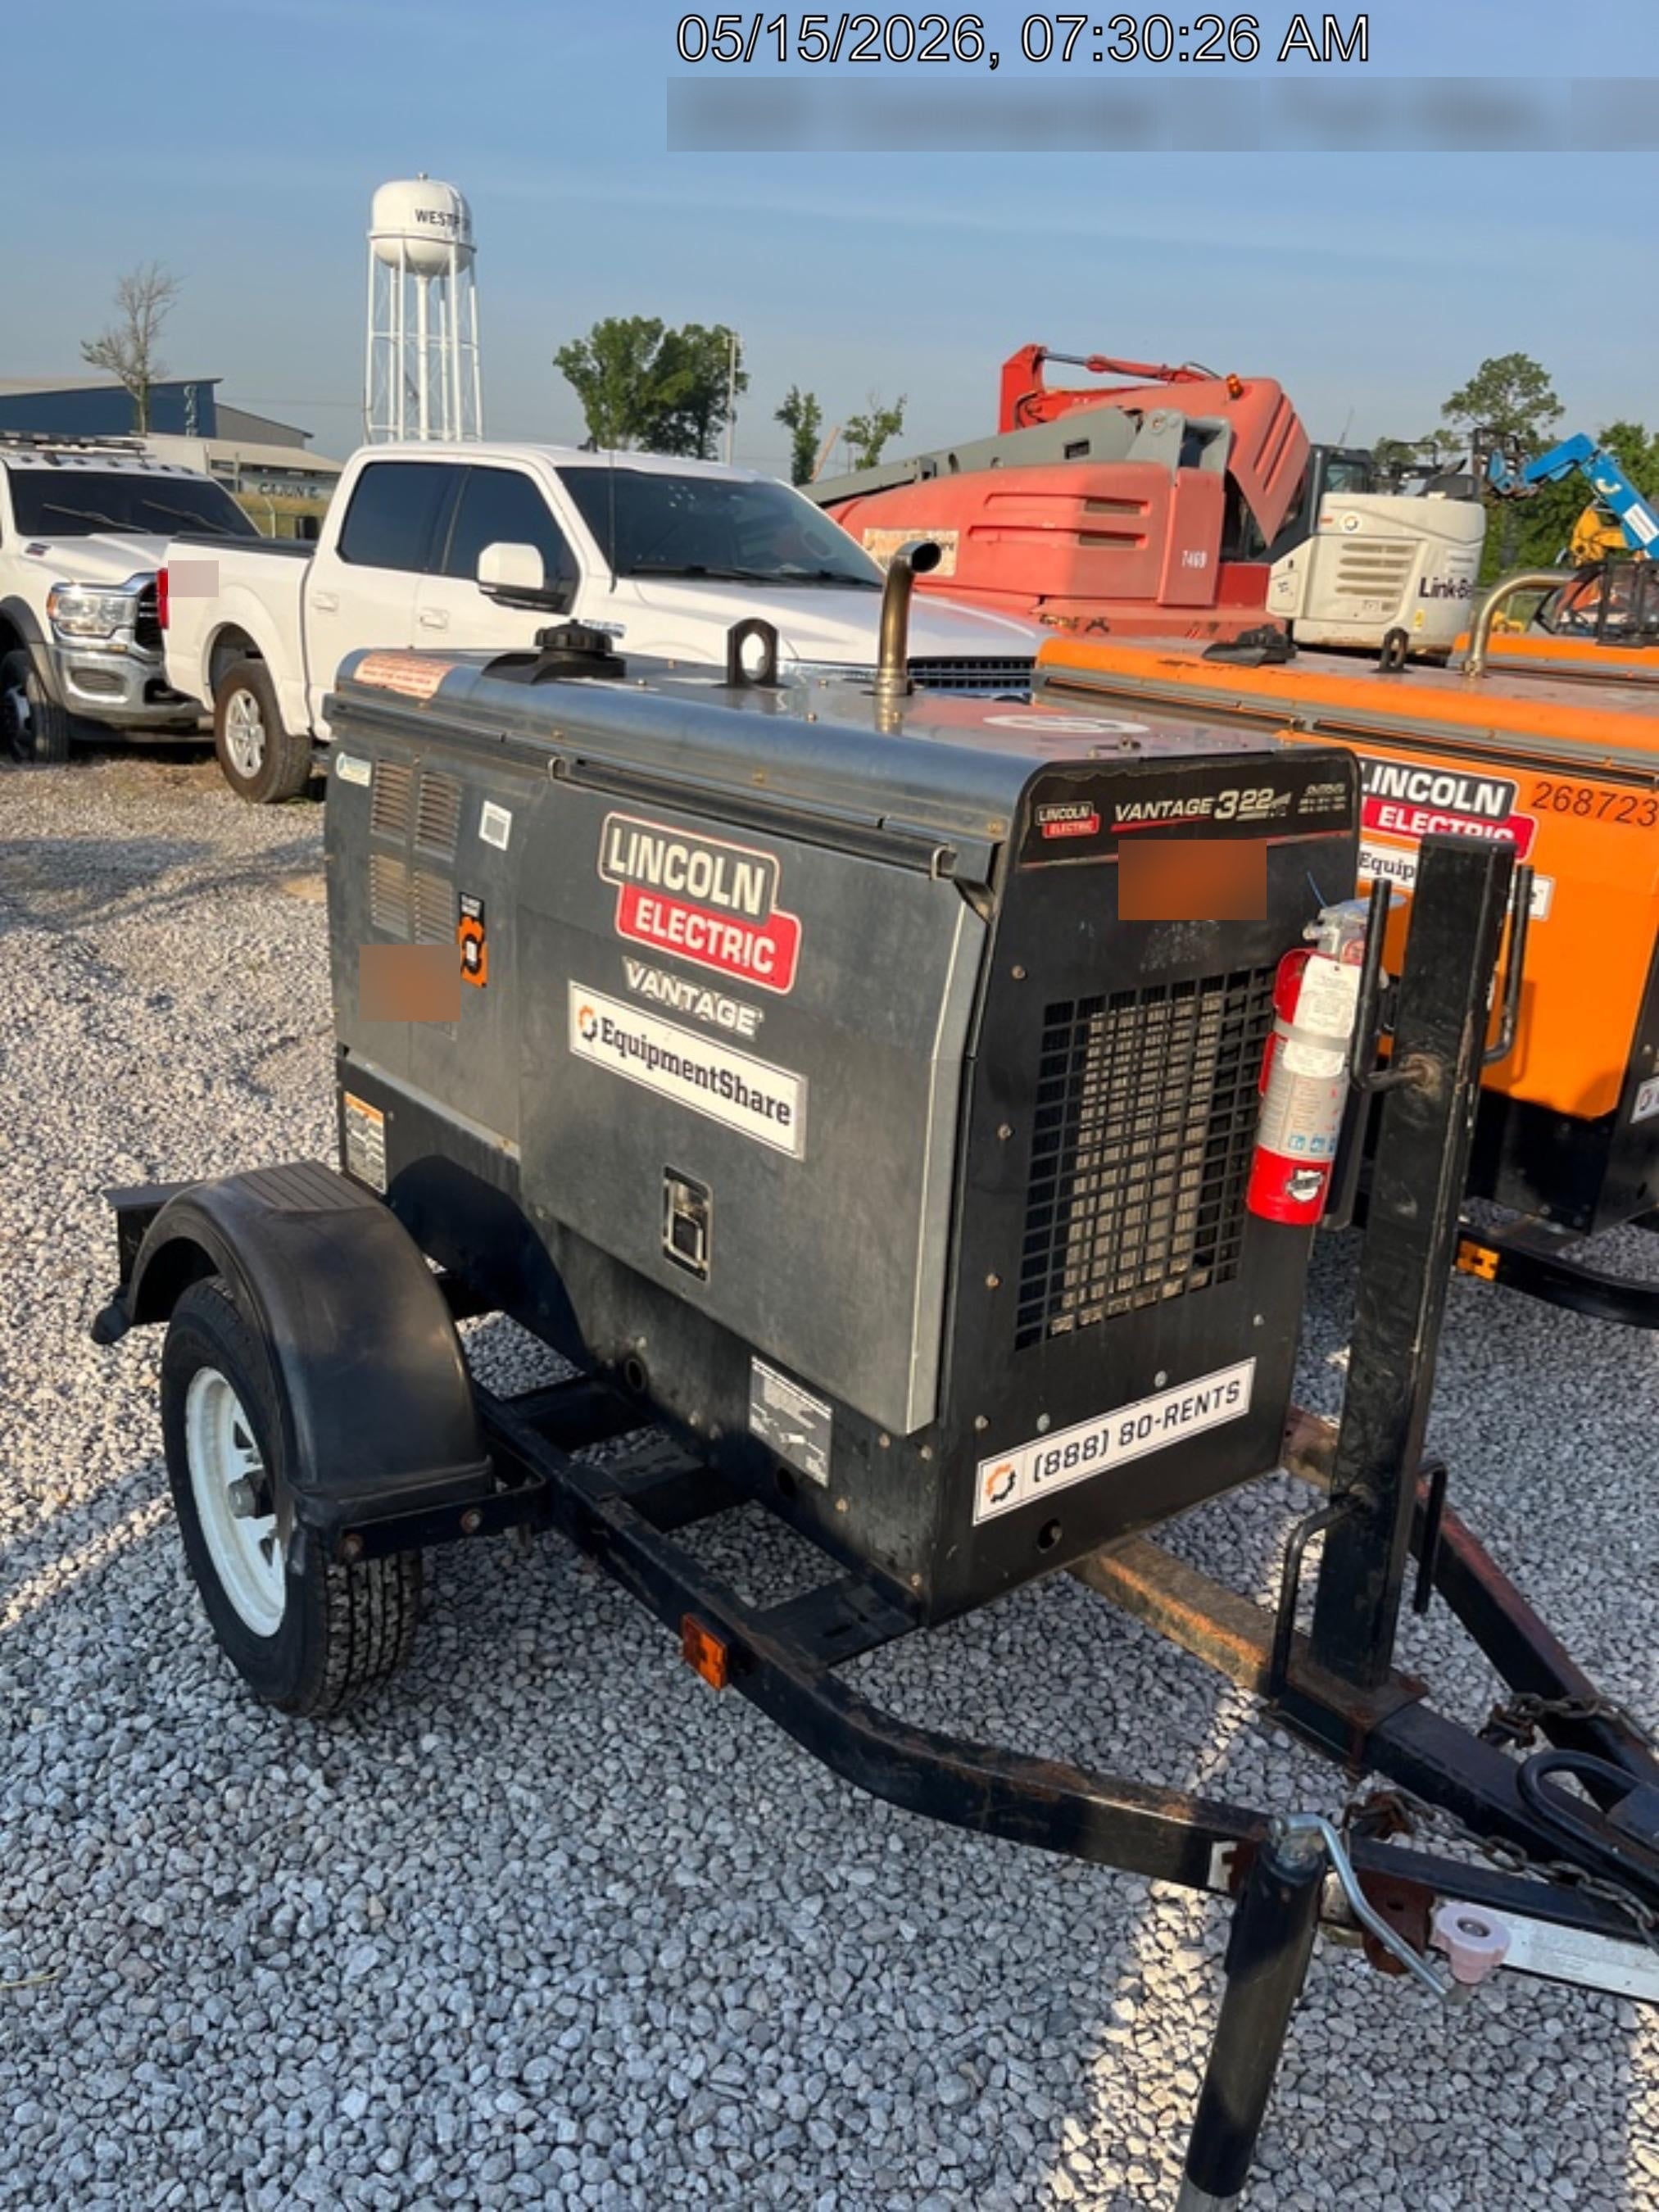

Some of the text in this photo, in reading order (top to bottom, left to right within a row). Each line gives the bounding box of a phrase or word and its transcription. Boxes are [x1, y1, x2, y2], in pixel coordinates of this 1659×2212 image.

[1038, 805, 1090, 823] LINCOLN
[1115, 797, 1215, 823] VANTAGE
[1214, 787, 1275, 820] 322
[1530, 781, 1659, 827] 268723
[609, 827, 767, 916] LINCOLN
[634, 896, 777, 975] ELECTRIC
[622, 955, 764, 1038] VANTAGE
[601, 1017, 791, 1126] EquipmentShare
[1034, 1380, 1241, 1483] (888) 80-RENTS
